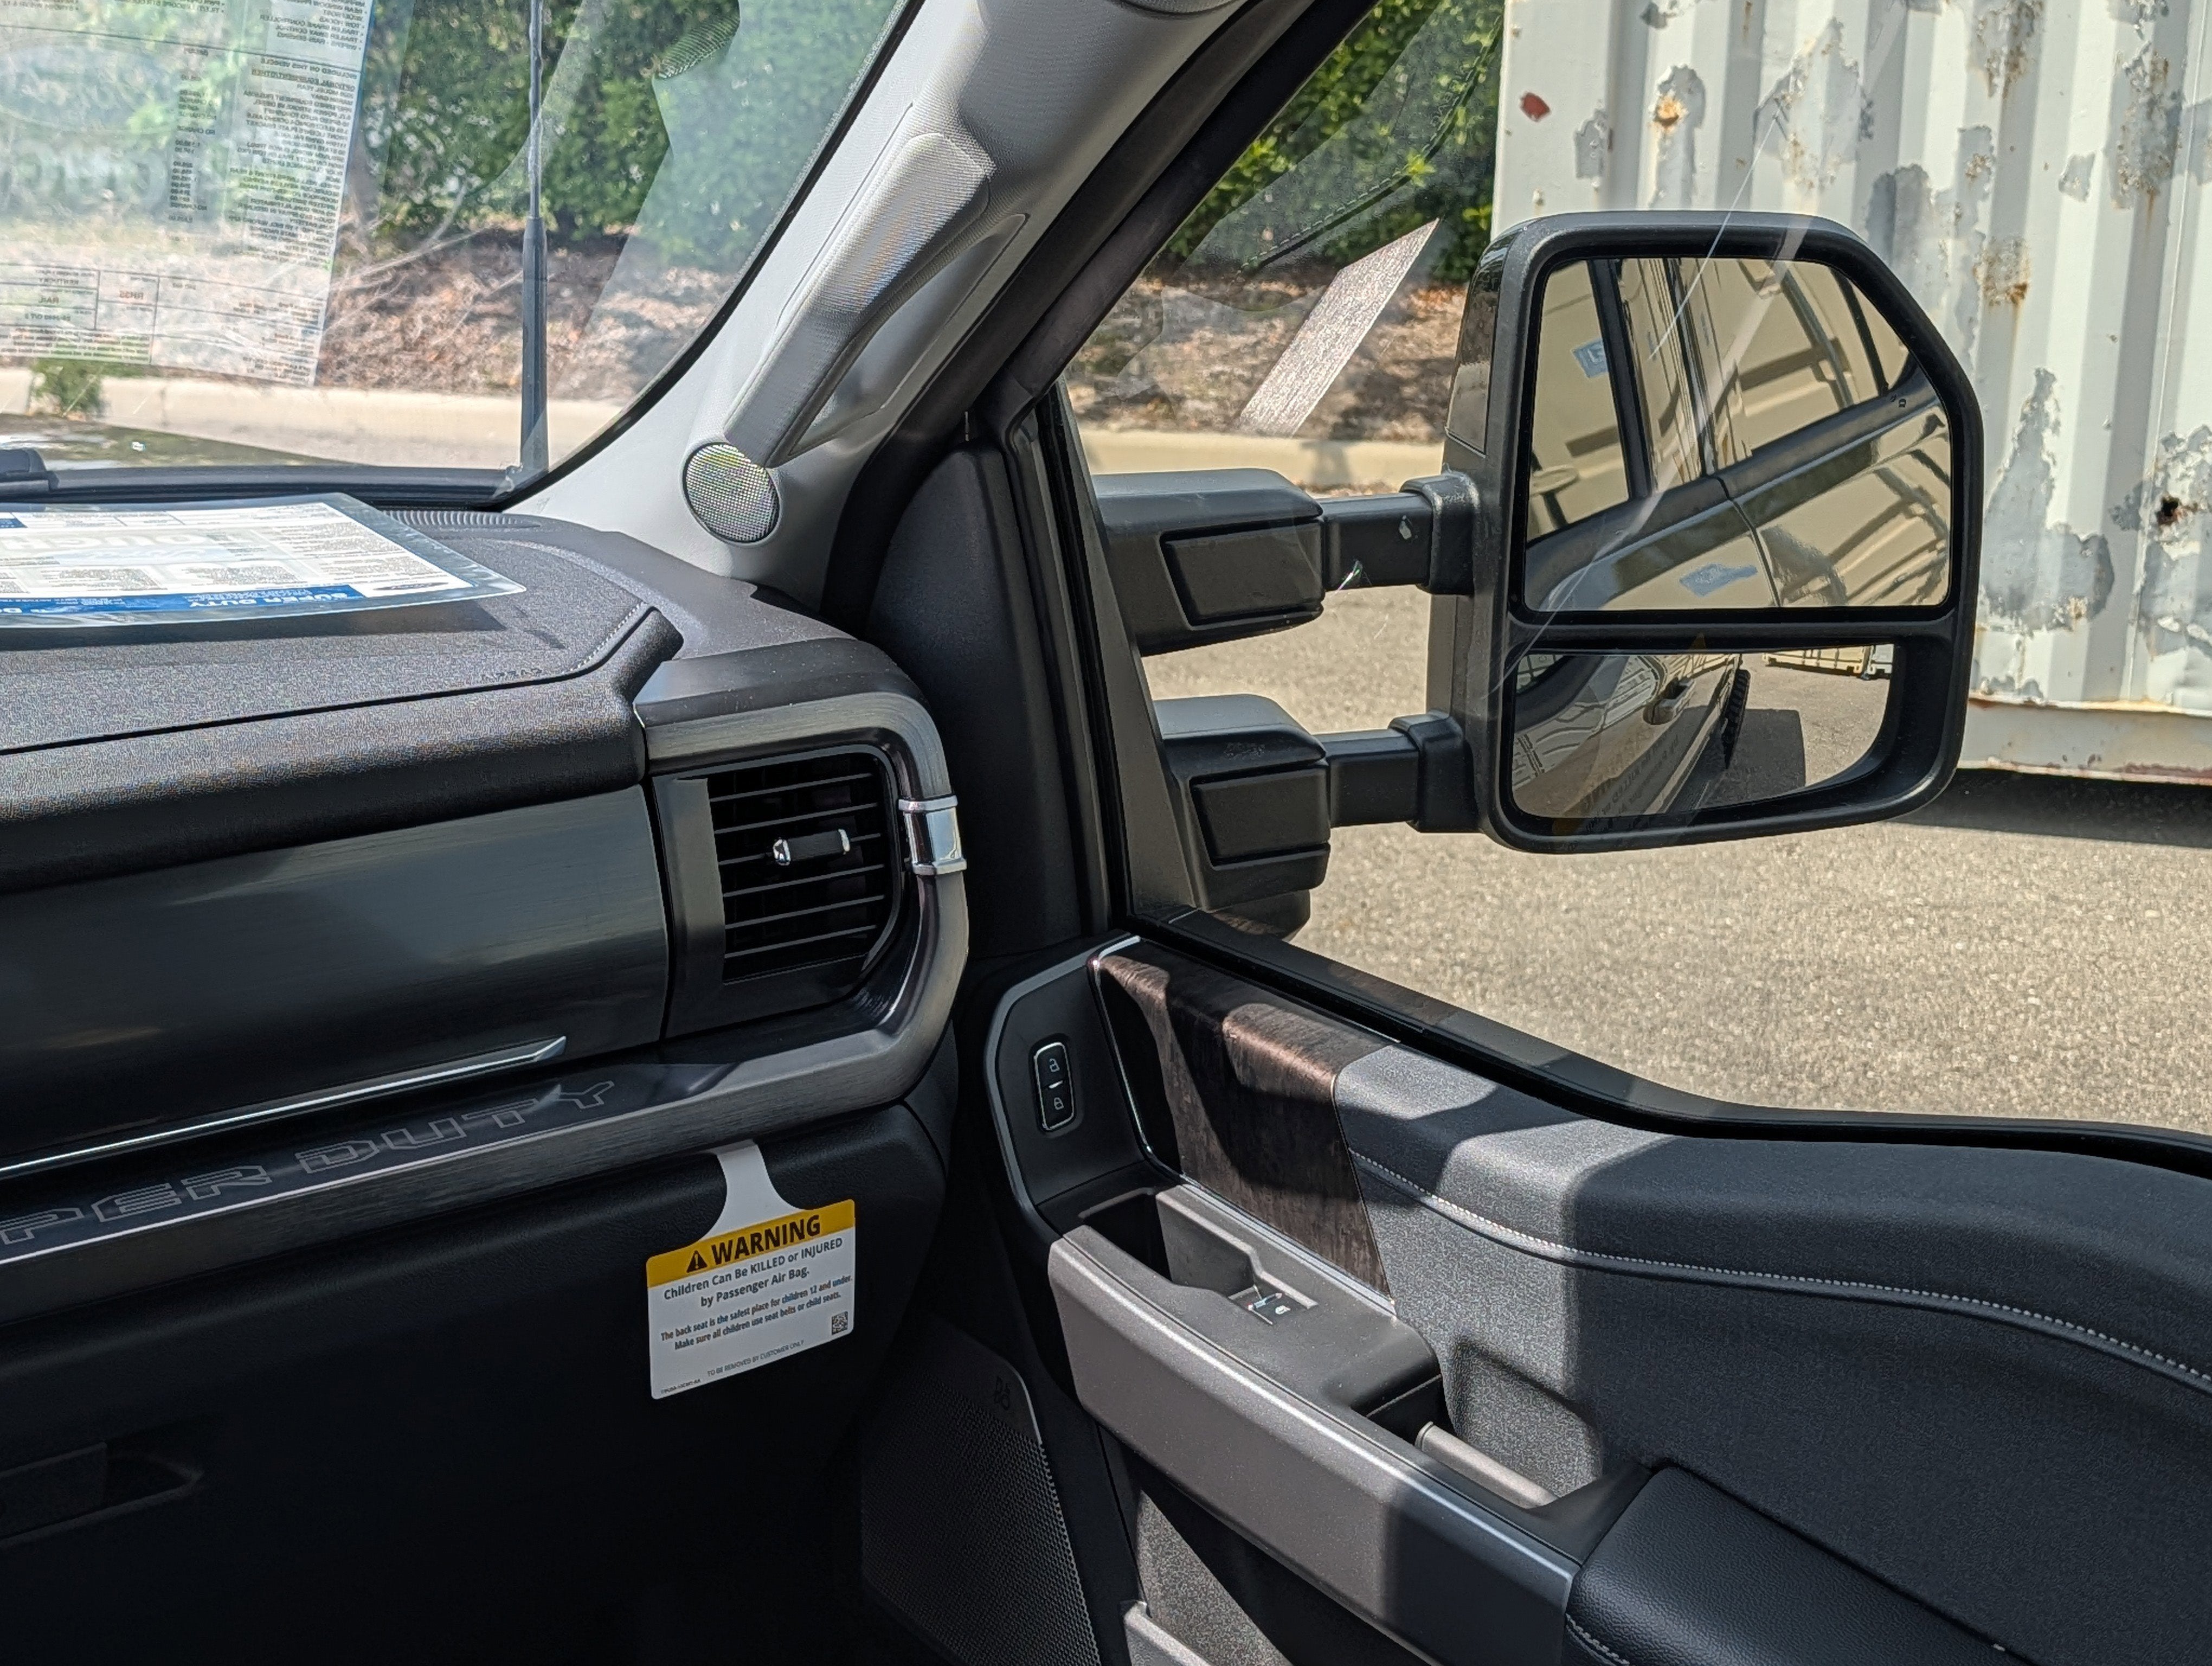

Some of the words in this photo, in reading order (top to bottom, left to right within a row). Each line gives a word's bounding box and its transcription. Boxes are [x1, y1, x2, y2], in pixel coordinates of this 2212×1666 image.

[294, 1080, 615, 1178] DUTY
[664, 1279, 709, 1300] Children
[712, 1273, 732, 1286] Can
[735, 1268, 748, 1279] Be
[750, 1256, 785, 1274] KILLED
[788, 1253, 798, 1261] or
[801, 1238, 843, 1259] INJURED
[711, 1214, 821, 1266] WARNING
[661, 1330, 673, 1341] The
[676, 1326, 692, 1337] back
[693, 1321, 708, 1331] seat
[710, 1318, 716, 1327] is
[717, 1314, 728, 1324] the
[729, 1306, 750, 1321] safest
[751, 1302, 769, 1316] place
[770, 1297, 780, 1307] for
[782, 1289, 808, 1304] children
[810, 1286, 818, 1295] 12
[819, 1281, 831, 1292] and
[832, 1274, 853, 1287] under.
[700, 1295, 713, 1308] by
[716, 1280, 769, 1301] Passenger
[771, 1274, 785, 1285] Air
[788, 1266, 810, 1280] Bag.
[674, 1338, 695, 1350] Make
[696, 1334, 711, 1344] sure
[712, 1329, 721, 1338] all
[723, 1321, 751, 1335] children
[751, 1317, 763, 1327] use
[764, 1311, 779, 1322] seat
[780, 1306, 796, 1318] belts
[797, 1303, 806, 1311] or
[806, 1296, 822, 1309] child
[822, 1291, 841, 1303] seats.
